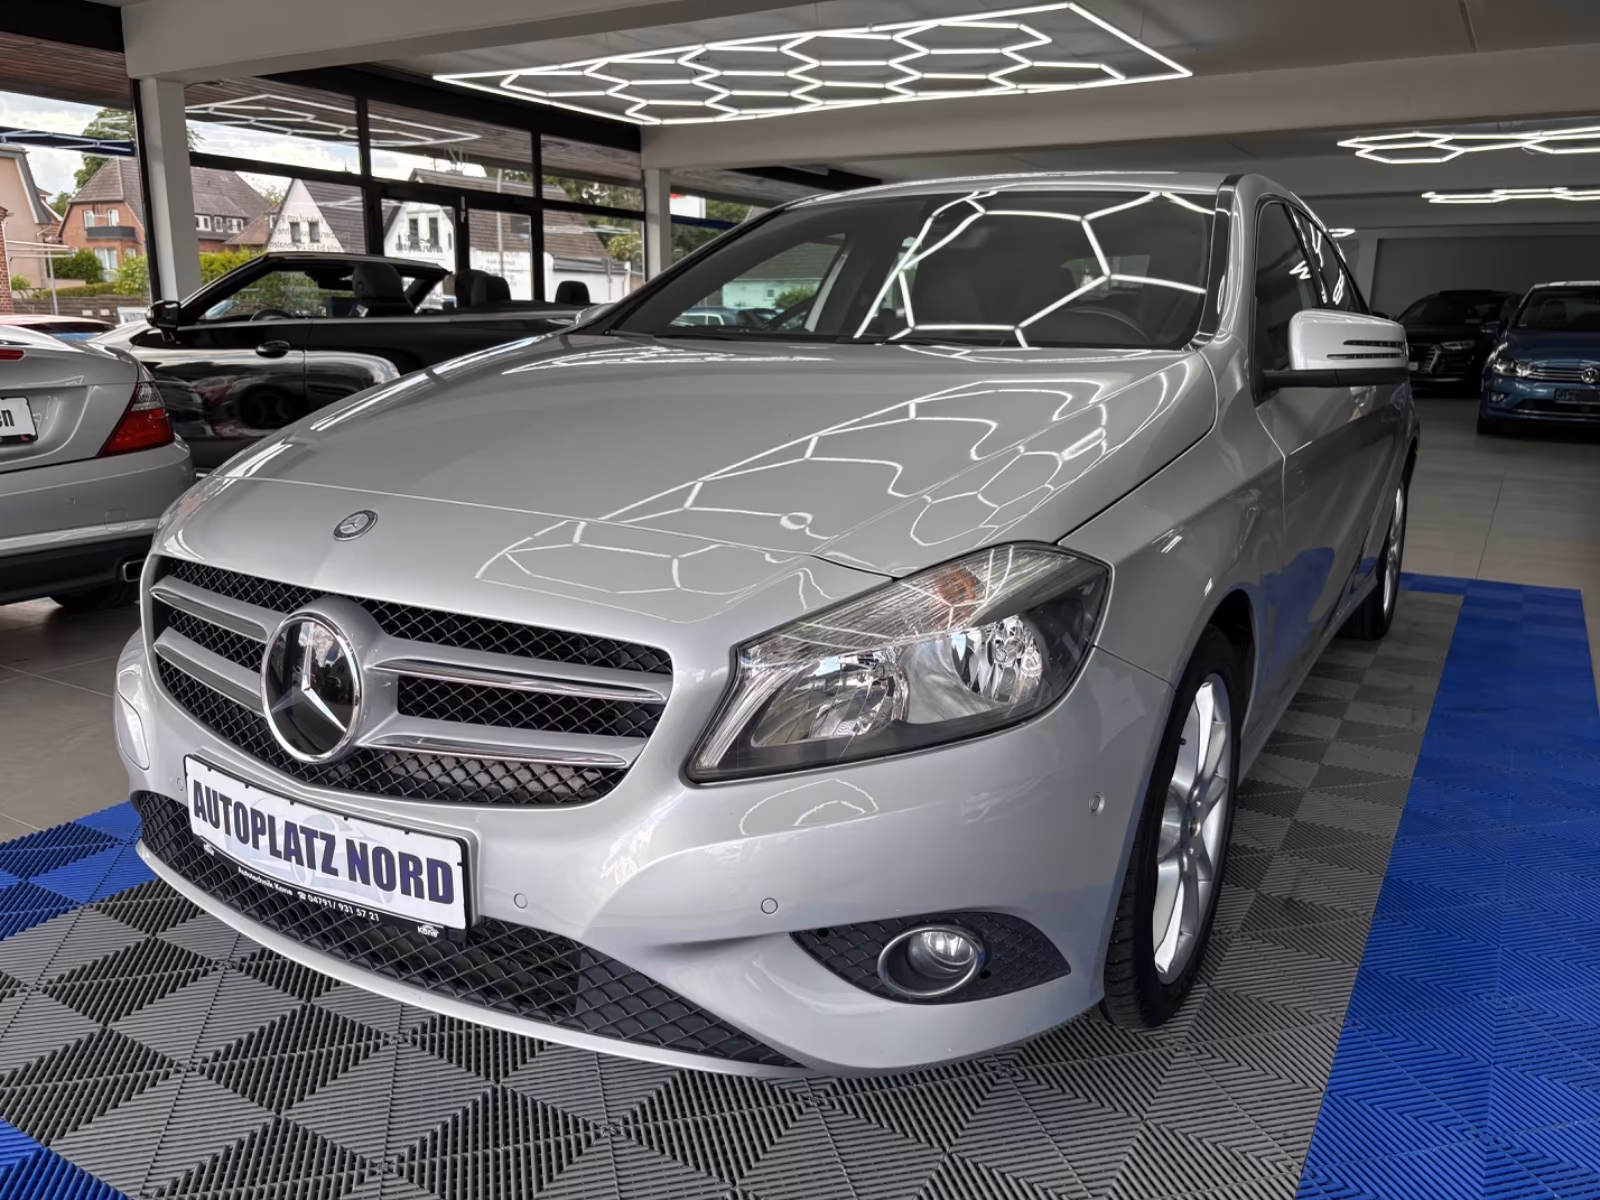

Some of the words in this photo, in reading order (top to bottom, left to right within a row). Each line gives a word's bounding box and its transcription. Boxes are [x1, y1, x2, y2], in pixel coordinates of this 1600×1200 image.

[193, 779, 339, 877] AUTOPLATZ
[345, 838, 454, 905] NORD
[369, 911, 380, 922] 21
